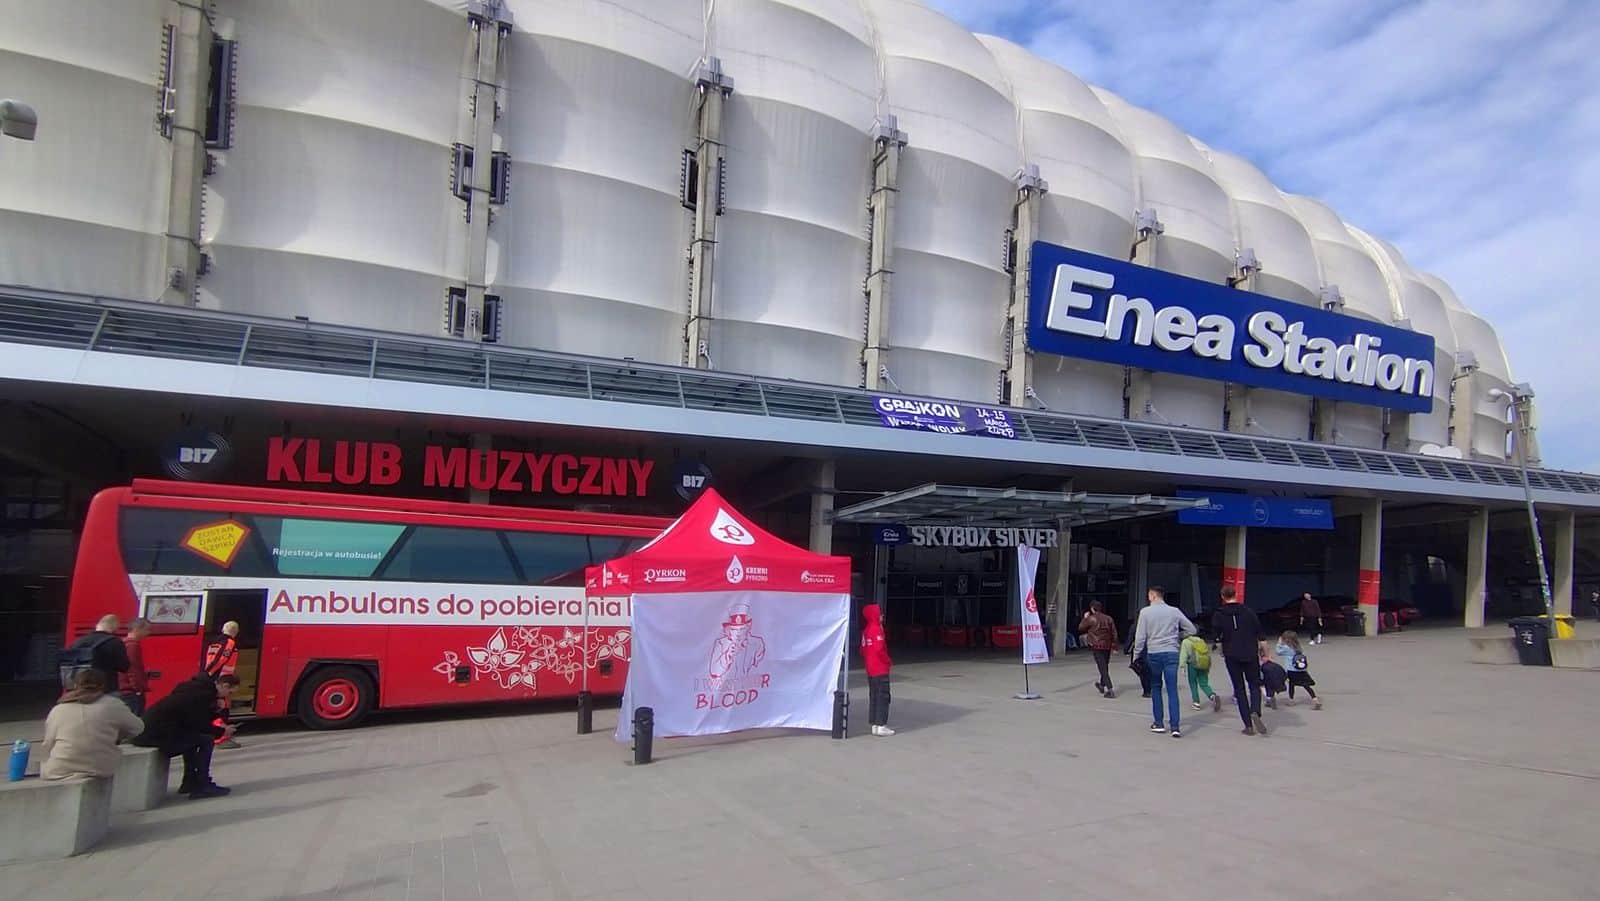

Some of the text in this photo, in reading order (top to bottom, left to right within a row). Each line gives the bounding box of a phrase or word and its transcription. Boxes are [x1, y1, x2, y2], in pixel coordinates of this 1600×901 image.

[1046, 263, 1434, 397] Enea Stadion
[976, 408, 1006, 420] 14-15
[266, 437, 654, 497] KLUB MUZYCZNY
[911, 526, 1059, 548] SKYBOX SILVER
[272, 547, 323, 559] Rejestracja
[335, 550, 382, 560] autobusie!
[270, 589, 429, 614] Ambulans
[436, 594, 474, 616] do
[480, 595, 623, 620] pobierania
[695, 688, 759, 710] BLOOD
